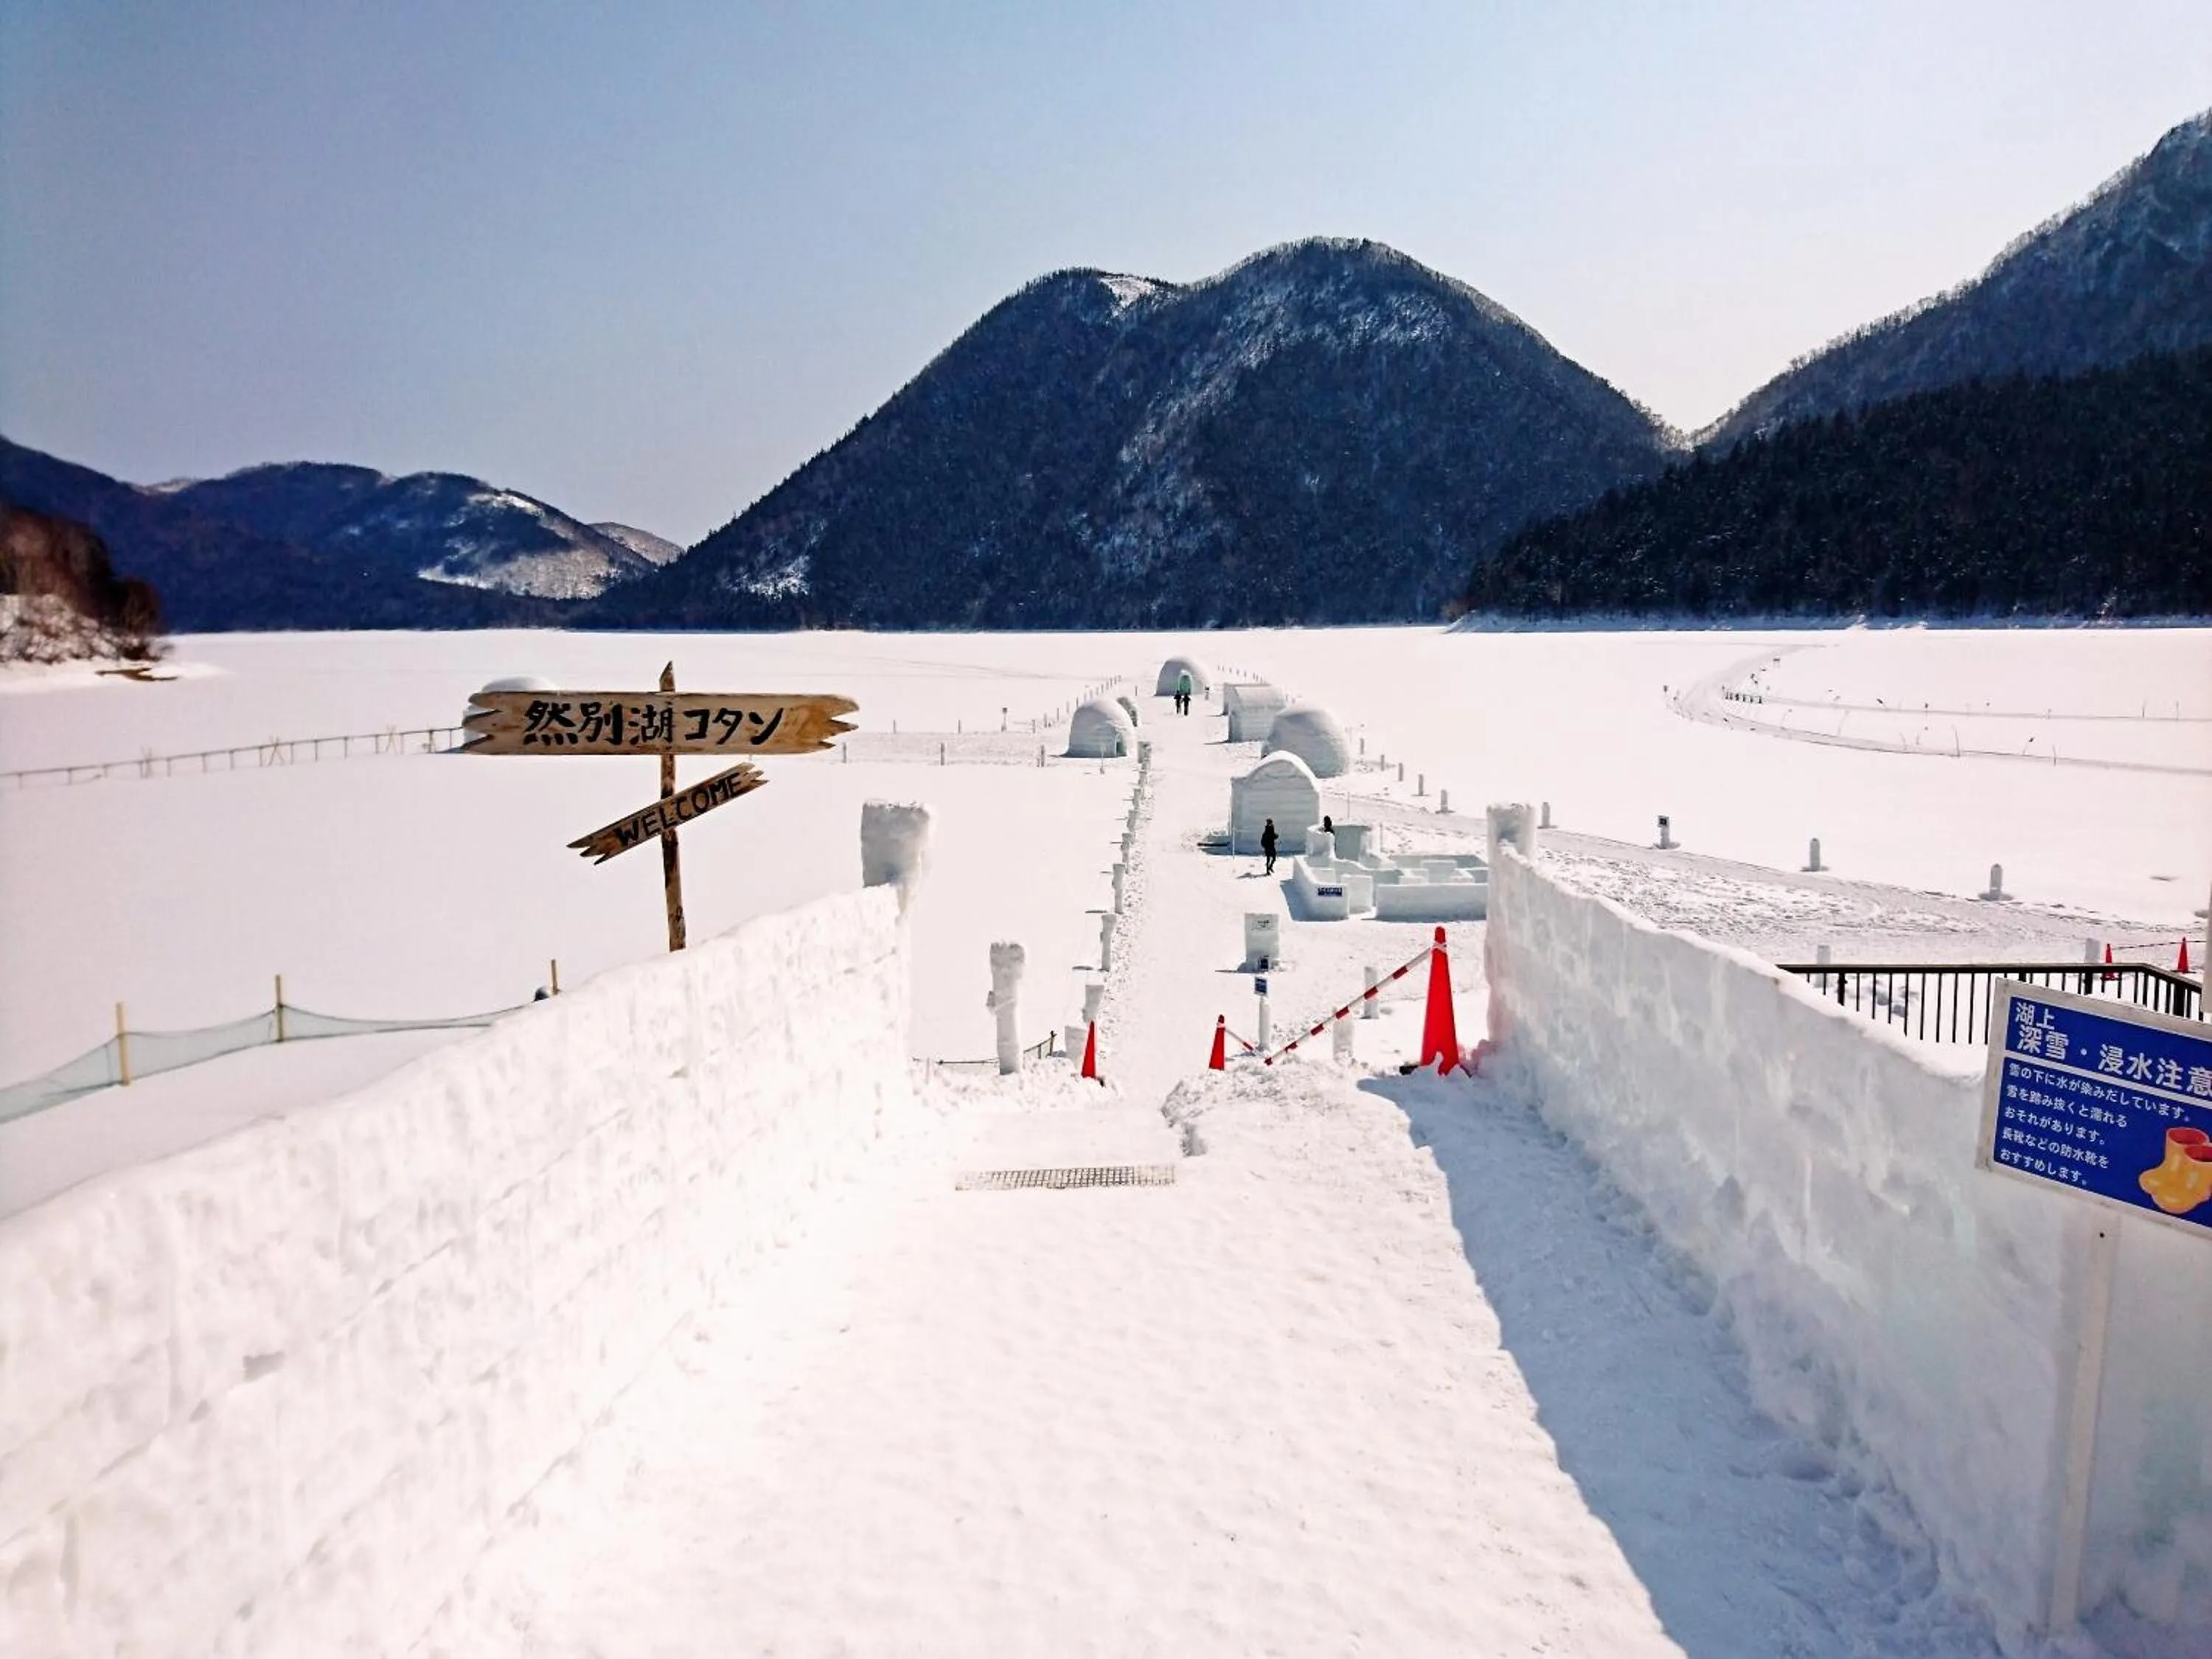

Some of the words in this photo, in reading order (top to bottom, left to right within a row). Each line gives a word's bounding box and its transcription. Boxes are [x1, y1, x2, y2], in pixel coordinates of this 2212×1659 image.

[523, 700, 784, 745] 然別湖コタン
[613, 771, 741, 848] WELCOME
[2015, 1002, 2056, 1031] 湖上
[2017, 1024, 2212, 1097] 深雪・浸水注意
[2005, 1106, 2105, 1145] おそれがあります。
[2000, 1148, 2087, 1186] おすすめします。
[2002, 1127, 2110, 1169] 長靴などの防水靴を
